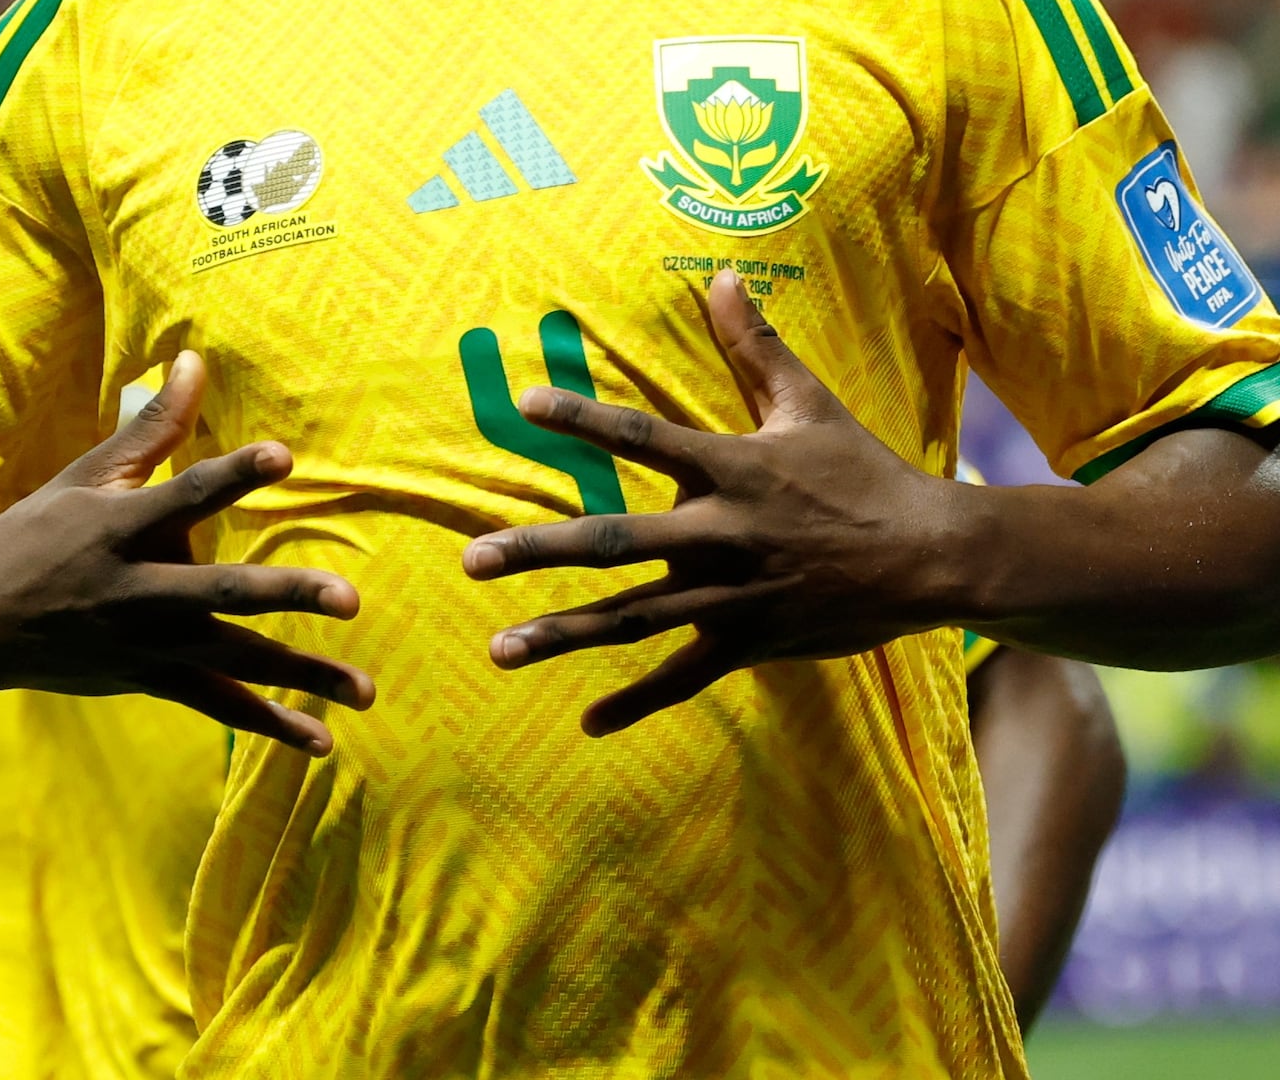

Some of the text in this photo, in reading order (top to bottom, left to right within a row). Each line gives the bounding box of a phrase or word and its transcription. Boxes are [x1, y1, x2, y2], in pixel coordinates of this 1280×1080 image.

[677, 195, 794, 227] SOUTH AFRICA
[192, 224, 336, 268] FOOTBALL ASSOCIATION
[211, 215, 307, 247] SOUTH AFRICAN
[663, 256, 713, 271] CZECHIA
[736, 259, 768, 277] SOUTH
[771, 263, 805, 281] AFRICA
[1182, 247, 1232, 301] PEACE
[750, 280, 773, 295] 2026
[1206, 286, 1231, 313] FIFA
[458, 309, 628, 517] 4
